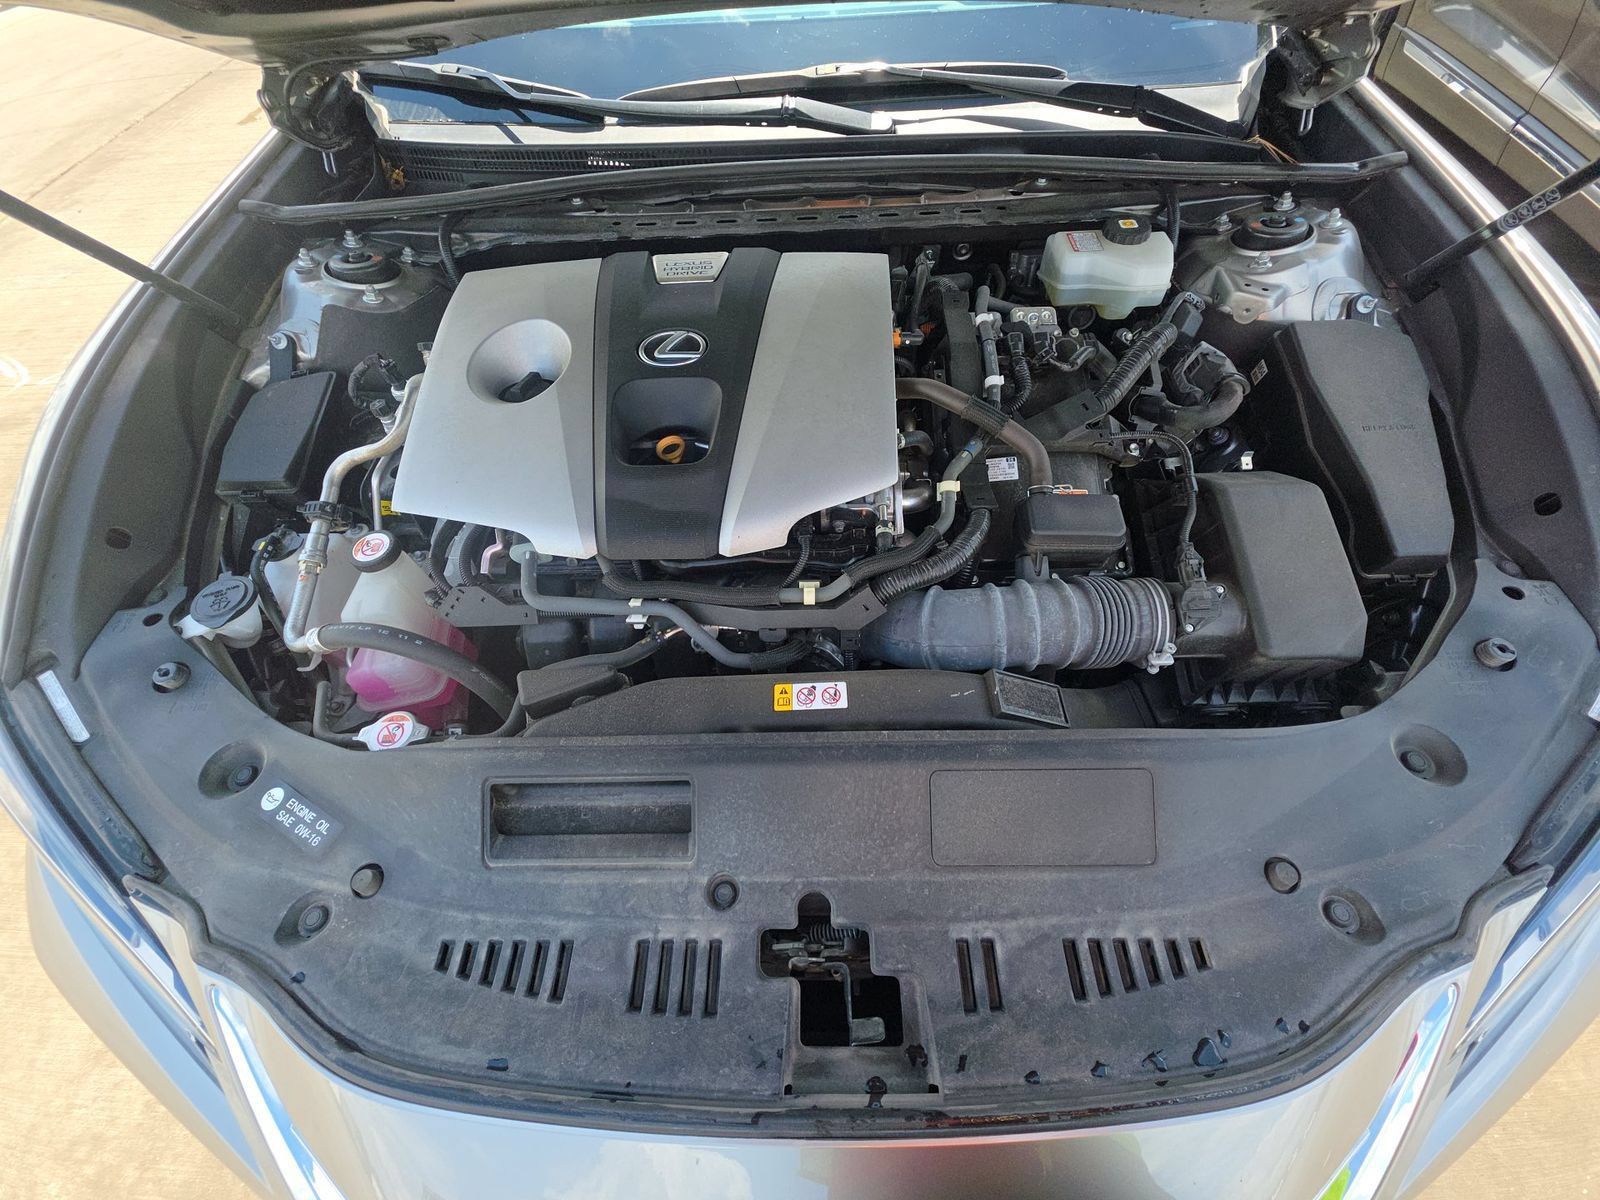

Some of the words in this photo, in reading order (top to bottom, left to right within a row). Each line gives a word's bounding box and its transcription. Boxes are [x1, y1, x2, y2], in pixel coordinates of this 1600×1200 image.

[275, 810, 296, 828] SAE
[294, 824, 321, 847] 0W-16
[285, 798, 317, 823] ENGINE
[315, 819, 330, 835] OIL
